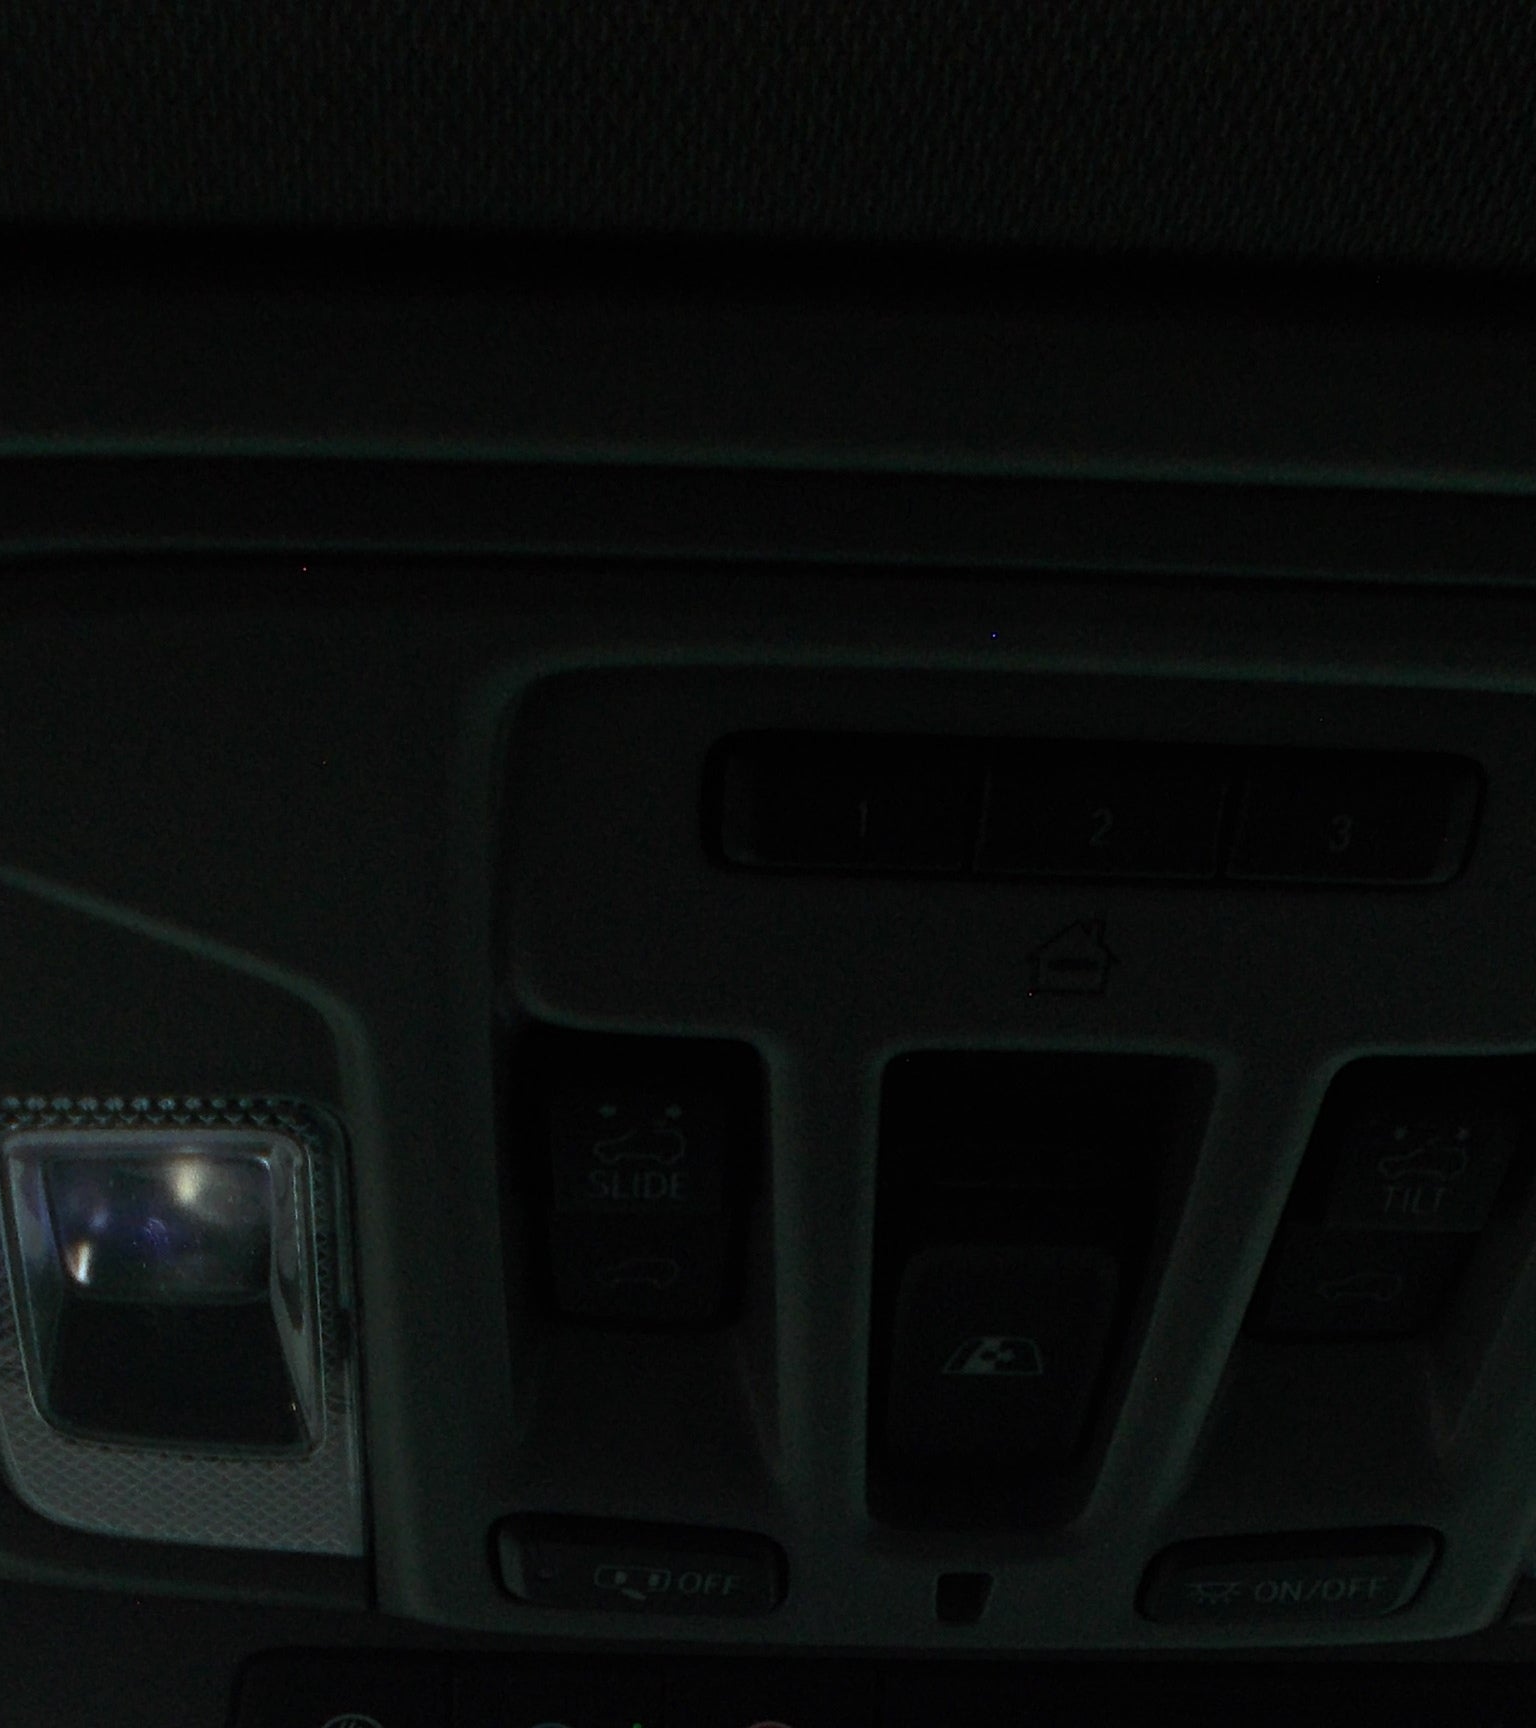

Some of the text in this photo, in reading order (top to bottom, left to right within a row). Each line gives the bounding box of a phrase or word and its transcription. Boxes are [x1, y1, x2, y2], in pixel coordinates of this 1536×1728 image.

[1087, 805, 1115, 848] 2
[1326, 812, 1355, 853] 3
[587, 1168, 689, 1200] SLIDE
[1381, 1183, 1451, 1214] TILT
[677, 1570, 741, 1597] OFF
[1252, 1575, 1389, 1602] ON/OFF
